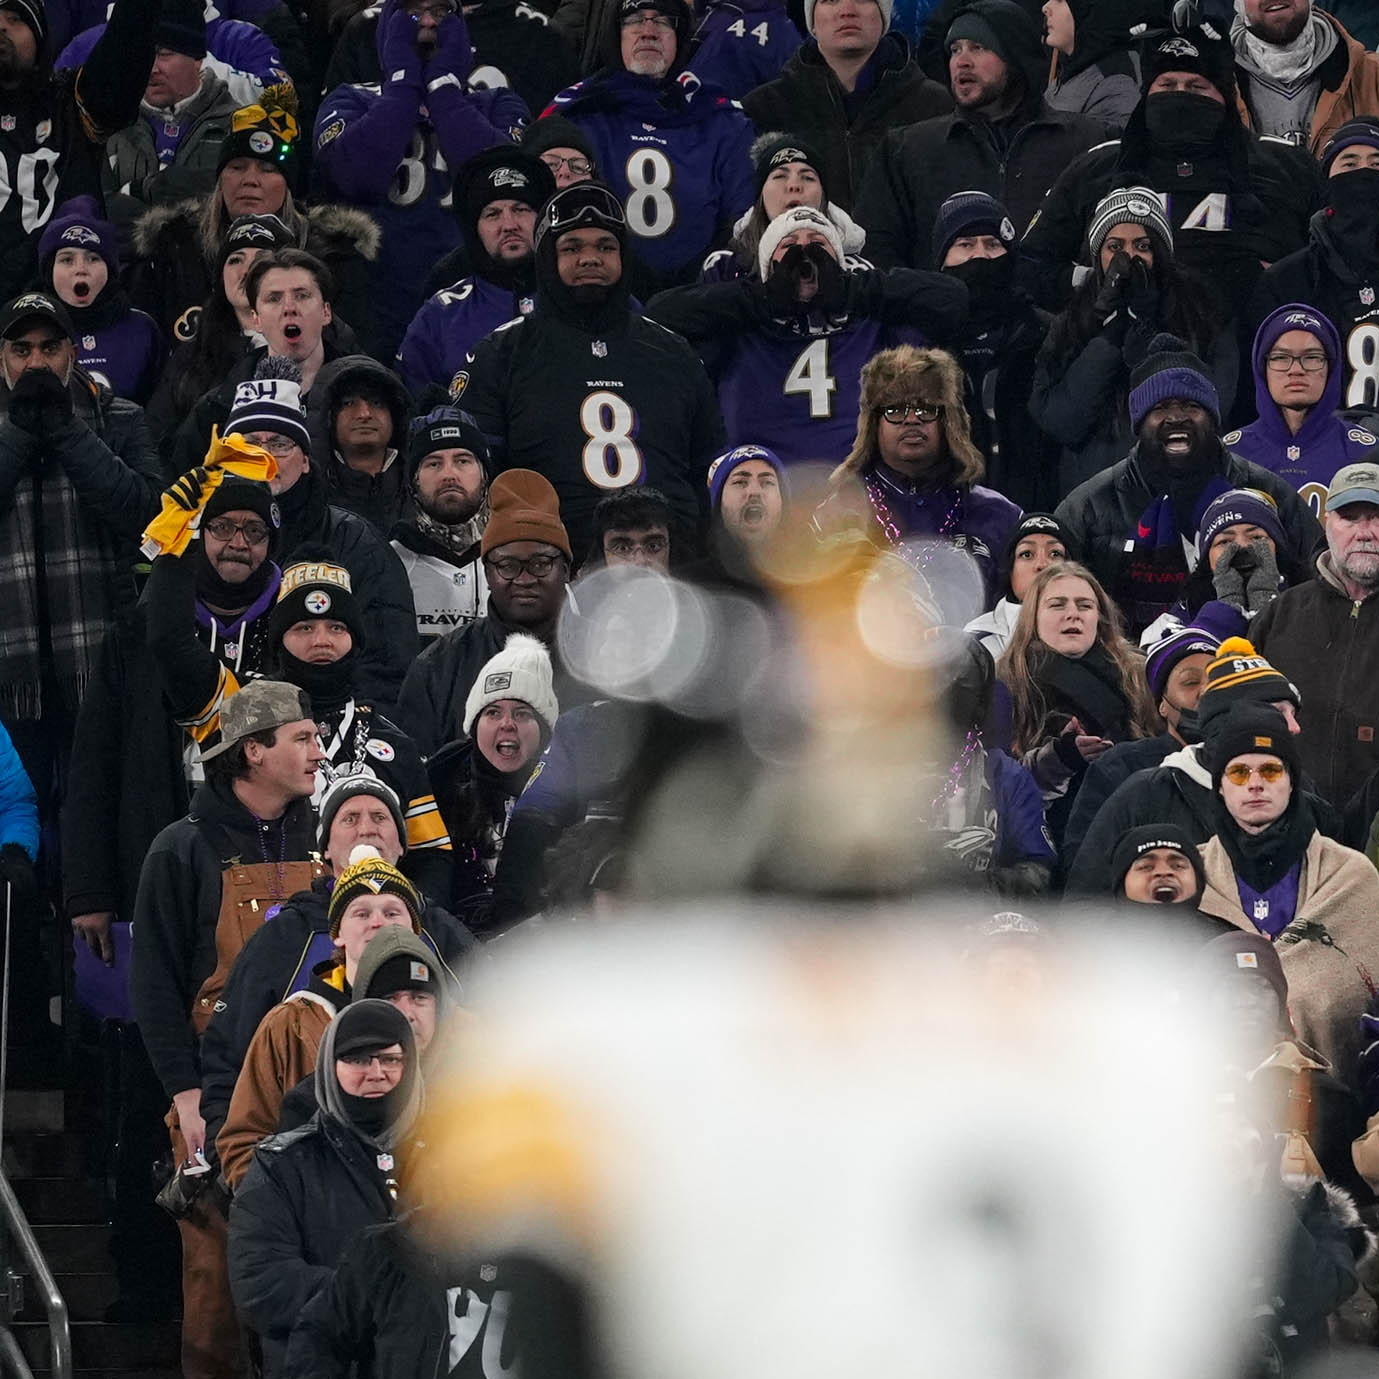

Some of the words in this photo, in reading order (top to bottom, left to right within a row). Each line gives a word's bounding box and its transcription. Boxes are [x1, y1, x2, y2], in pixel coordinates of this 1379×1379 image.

[727, 18, 769, 46] 44
[626, 147, 675, 238] 8
[783, 338, 836, 418] 4
[579, 390, 641, 489] 8
[278, 562, 352, 601] STEELER
